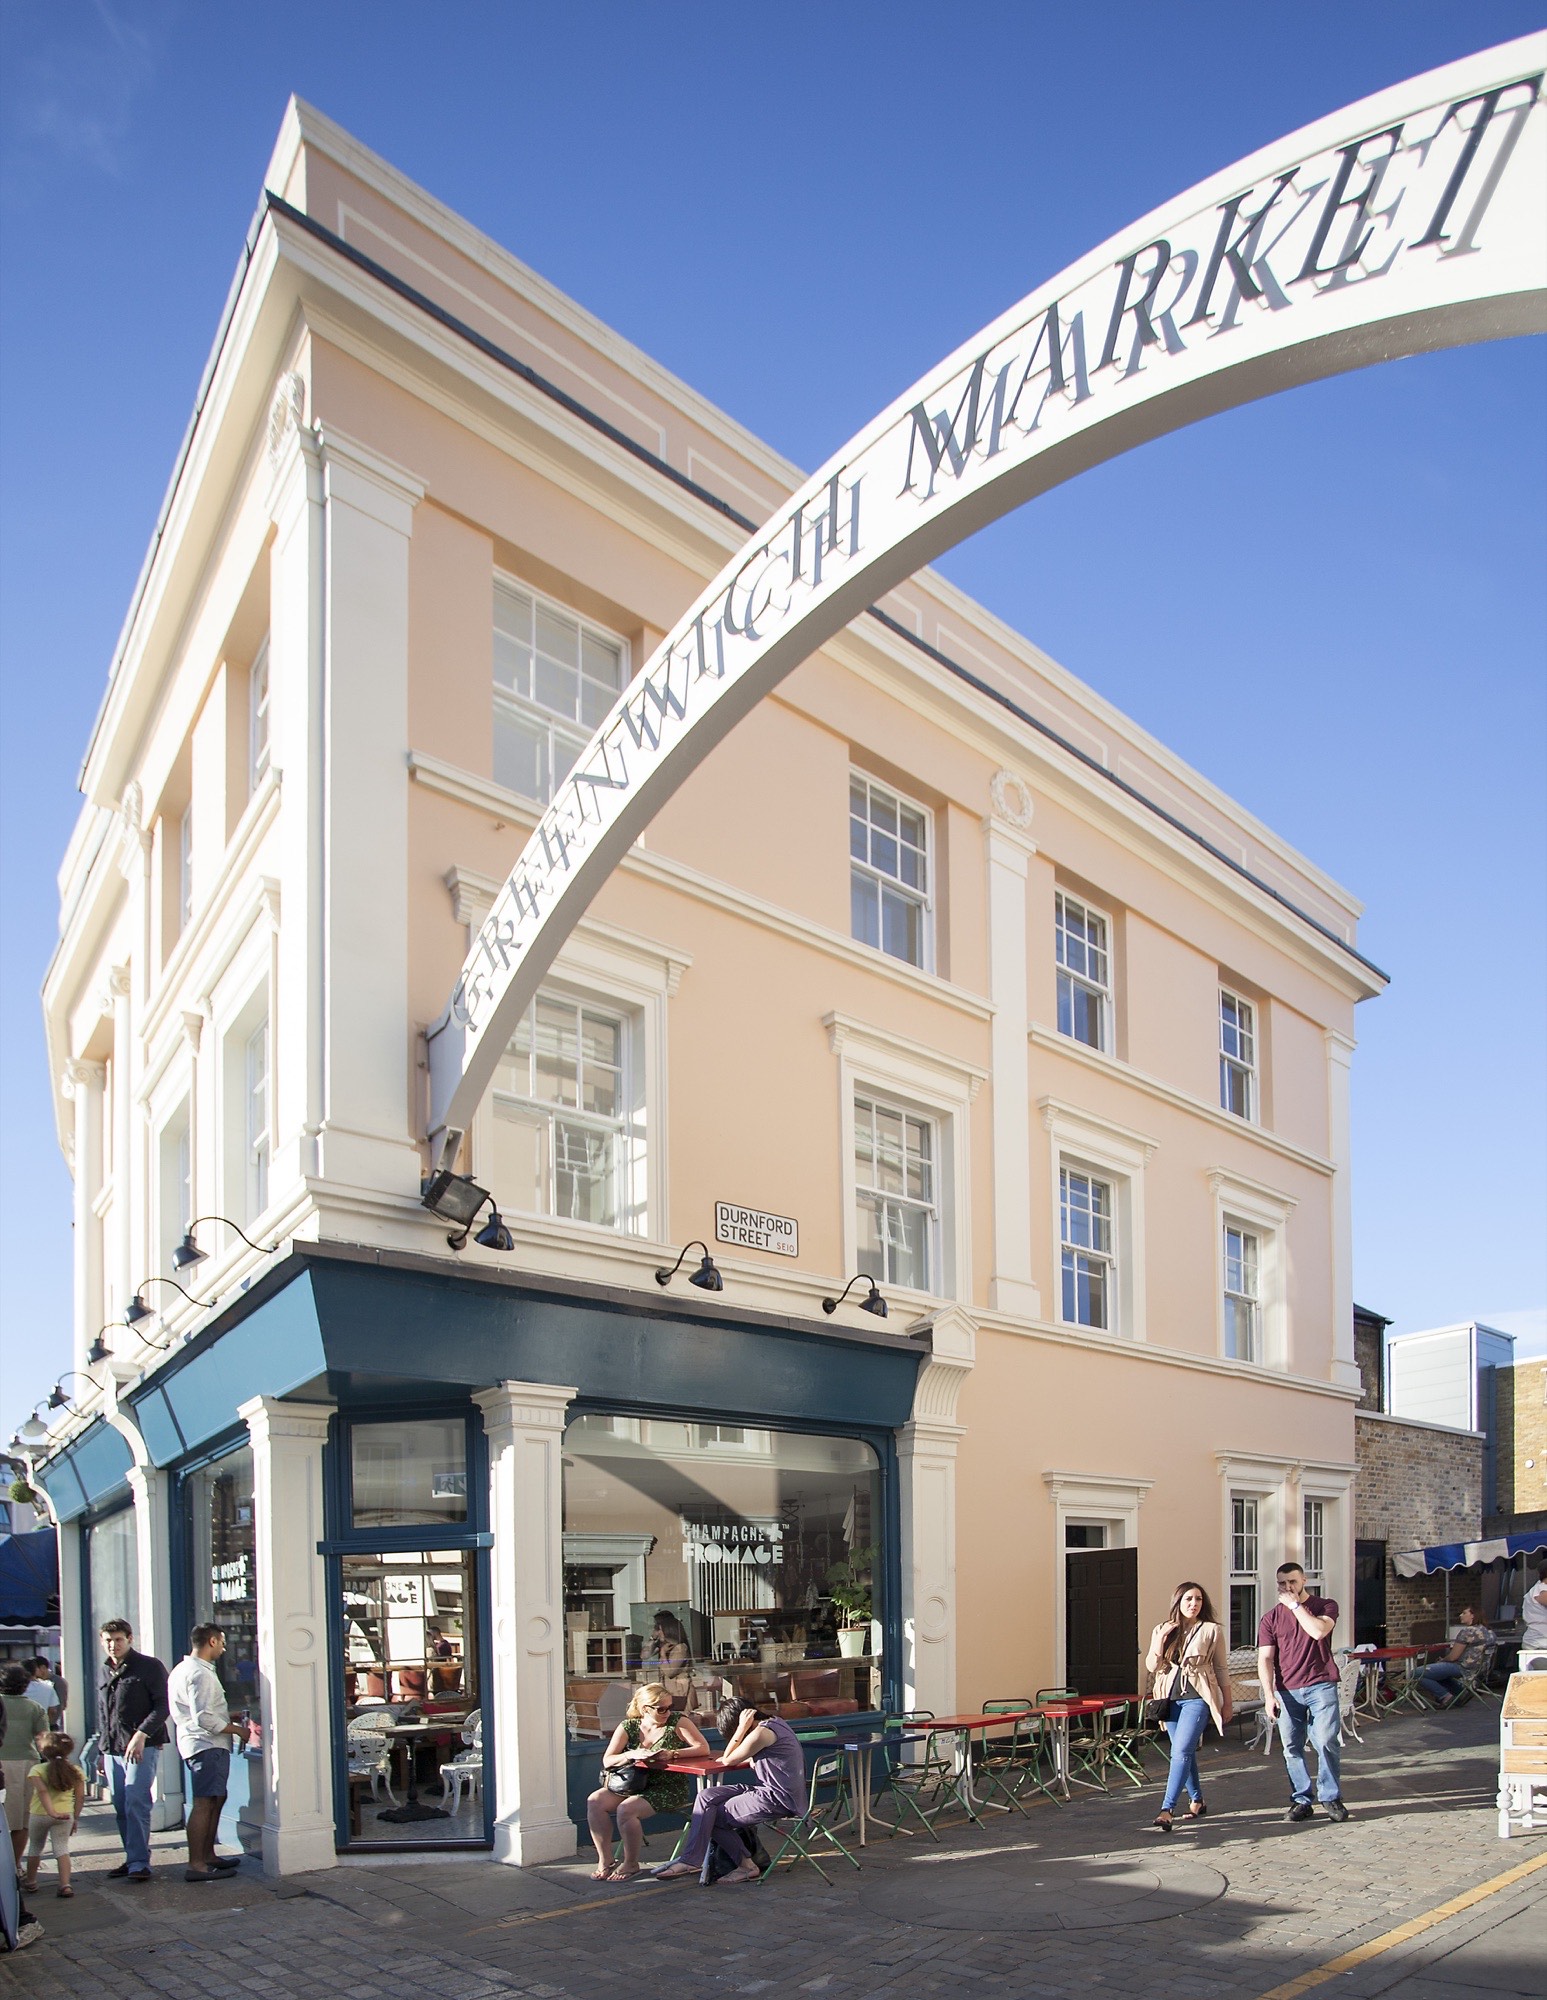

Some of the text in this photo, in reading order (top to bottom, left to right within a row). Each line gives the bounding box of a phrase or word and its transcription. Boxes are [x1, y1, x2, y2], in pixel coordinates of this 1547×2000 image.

[451, 72, 1546, 1031] GREENWICH MARKET
[720, 1206, 792, 1235] DURNFORD
[720, 1224, 795, 1253] STREET SE10
[682, 1523, 766, 1542] CHAMPAGNE
[682, 1543, 784, 1564] FROMAGE
